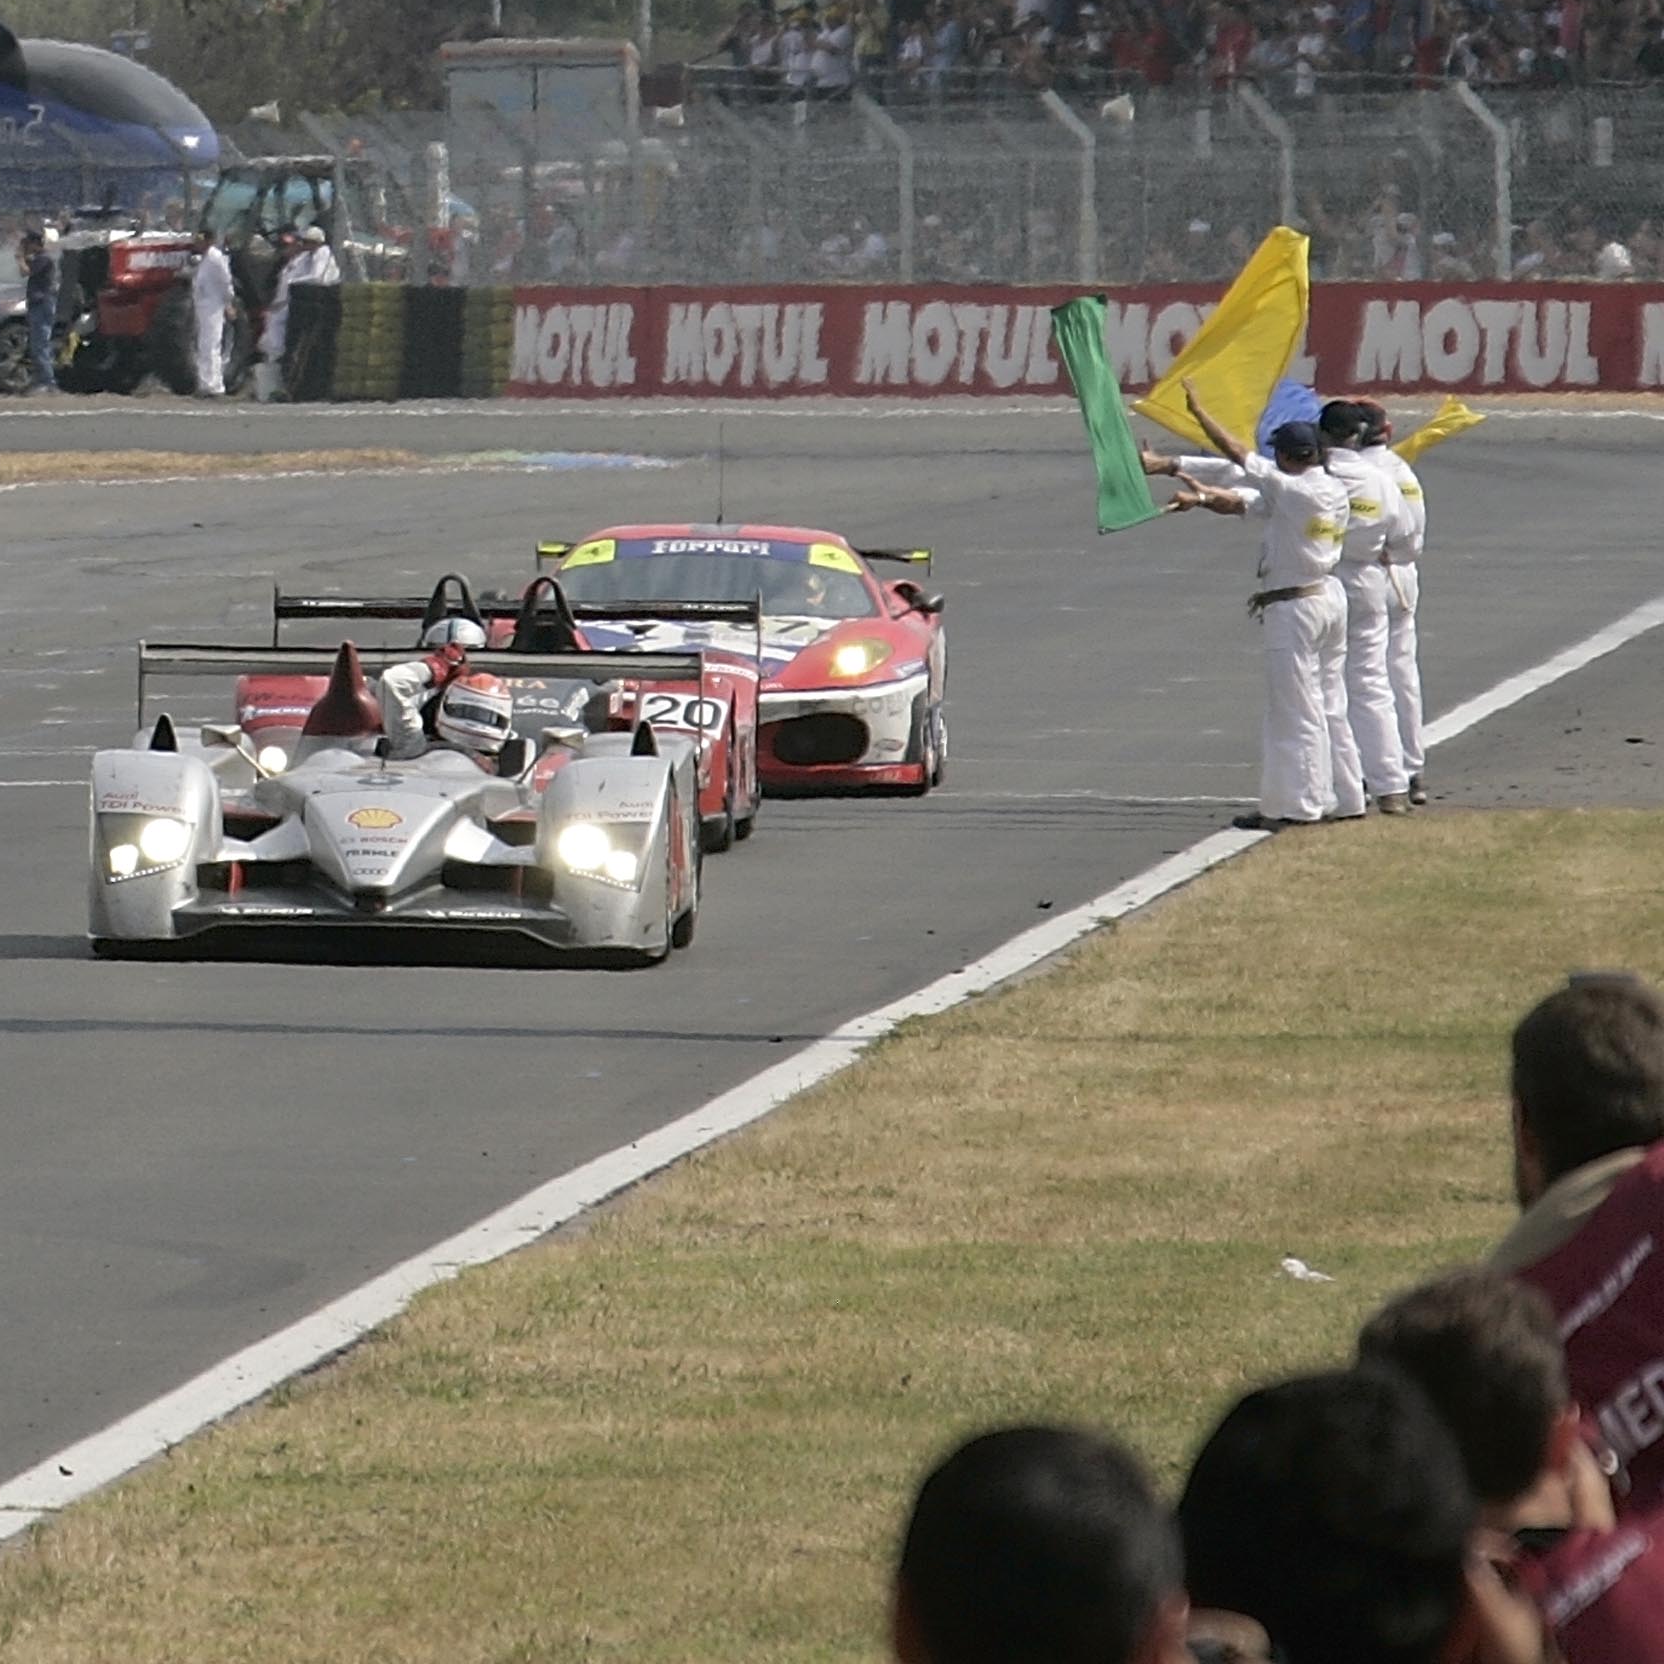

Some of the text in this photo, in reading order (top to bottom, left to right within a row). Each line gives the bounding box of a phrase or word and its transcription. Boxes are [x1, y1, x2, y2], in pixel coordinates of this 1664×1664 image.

[510, 303, 637, 386] MOTUL
[662, 302, 829, 386] MOTUL
[854, 301, 1058, 388] MOTUL
[1354, 296, 1599, 386] MOTUL
[651, 539, 770, 555] Ferrari
[644, 692, 723, 729] 20
[100, 800, 132, 811] TDI
